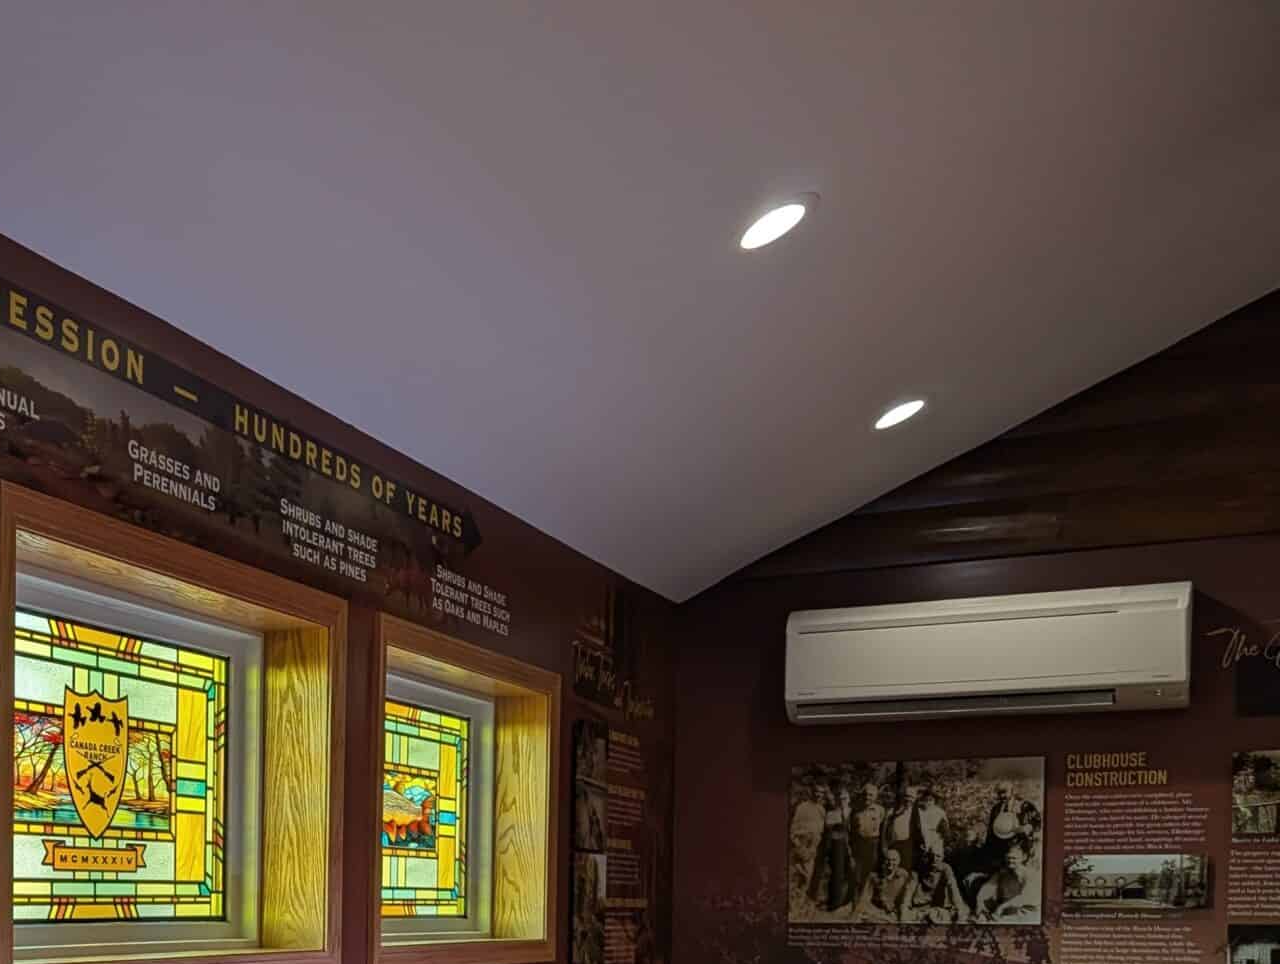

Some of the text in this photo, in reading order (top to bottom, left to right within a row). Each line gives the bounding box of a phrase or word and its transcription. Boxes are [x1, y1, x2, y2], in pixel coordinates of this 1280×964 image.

[127, 440, 221, 493] GRASSES AND
[234, 404, 362, 489] HUNDREDS
[372, 475, 397, 504] OF
[406, 491, 463, 538] YEARS
[133, 463, 217, 512] PERENNIALS
[280, 498, 379, 553] SHRUBS AND SHADE
[281, 519, 377, 569] INTOLERANT TREES
[292, 543, 367, 583] SUCH AS PINES
[430, 577, 469, 605] TOLERANT
[470, 596, 492, 615] TREES
[432, 597, 443, 611] AS
[70, 740, 121, 754] CANADA CREEK
[83, 750, 108, 761] RANCH
[1066, 752, 1148, 769] CLUBHOUSE
[1066, 769, 1168, 787] CONSTRUCTION
